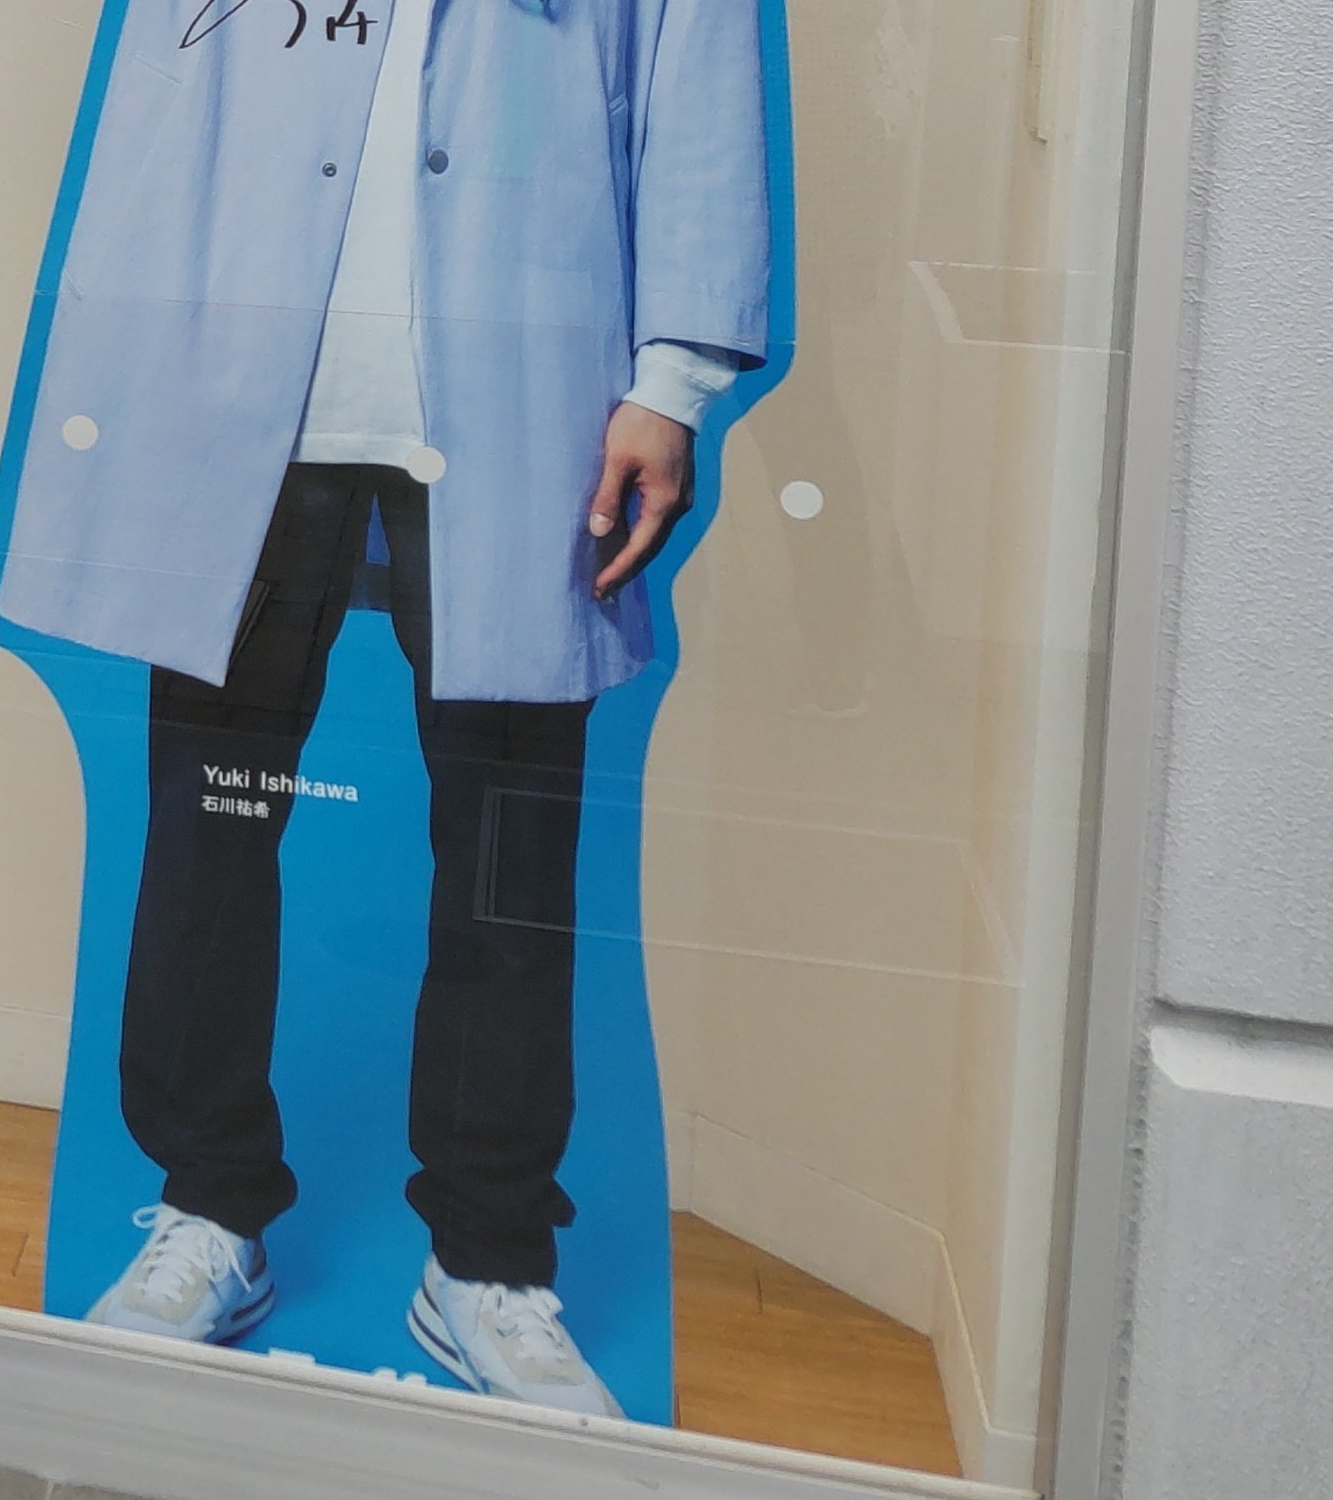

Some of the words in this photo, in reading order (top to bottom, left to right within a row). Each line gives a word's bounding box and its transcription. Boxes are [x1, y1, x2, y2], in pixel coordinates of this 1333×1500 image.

[203, 763, 251, 789] Yuki
[261, 771, 359, 802] Ishikawa
[201, 794, 271, 819] 石川祐希
